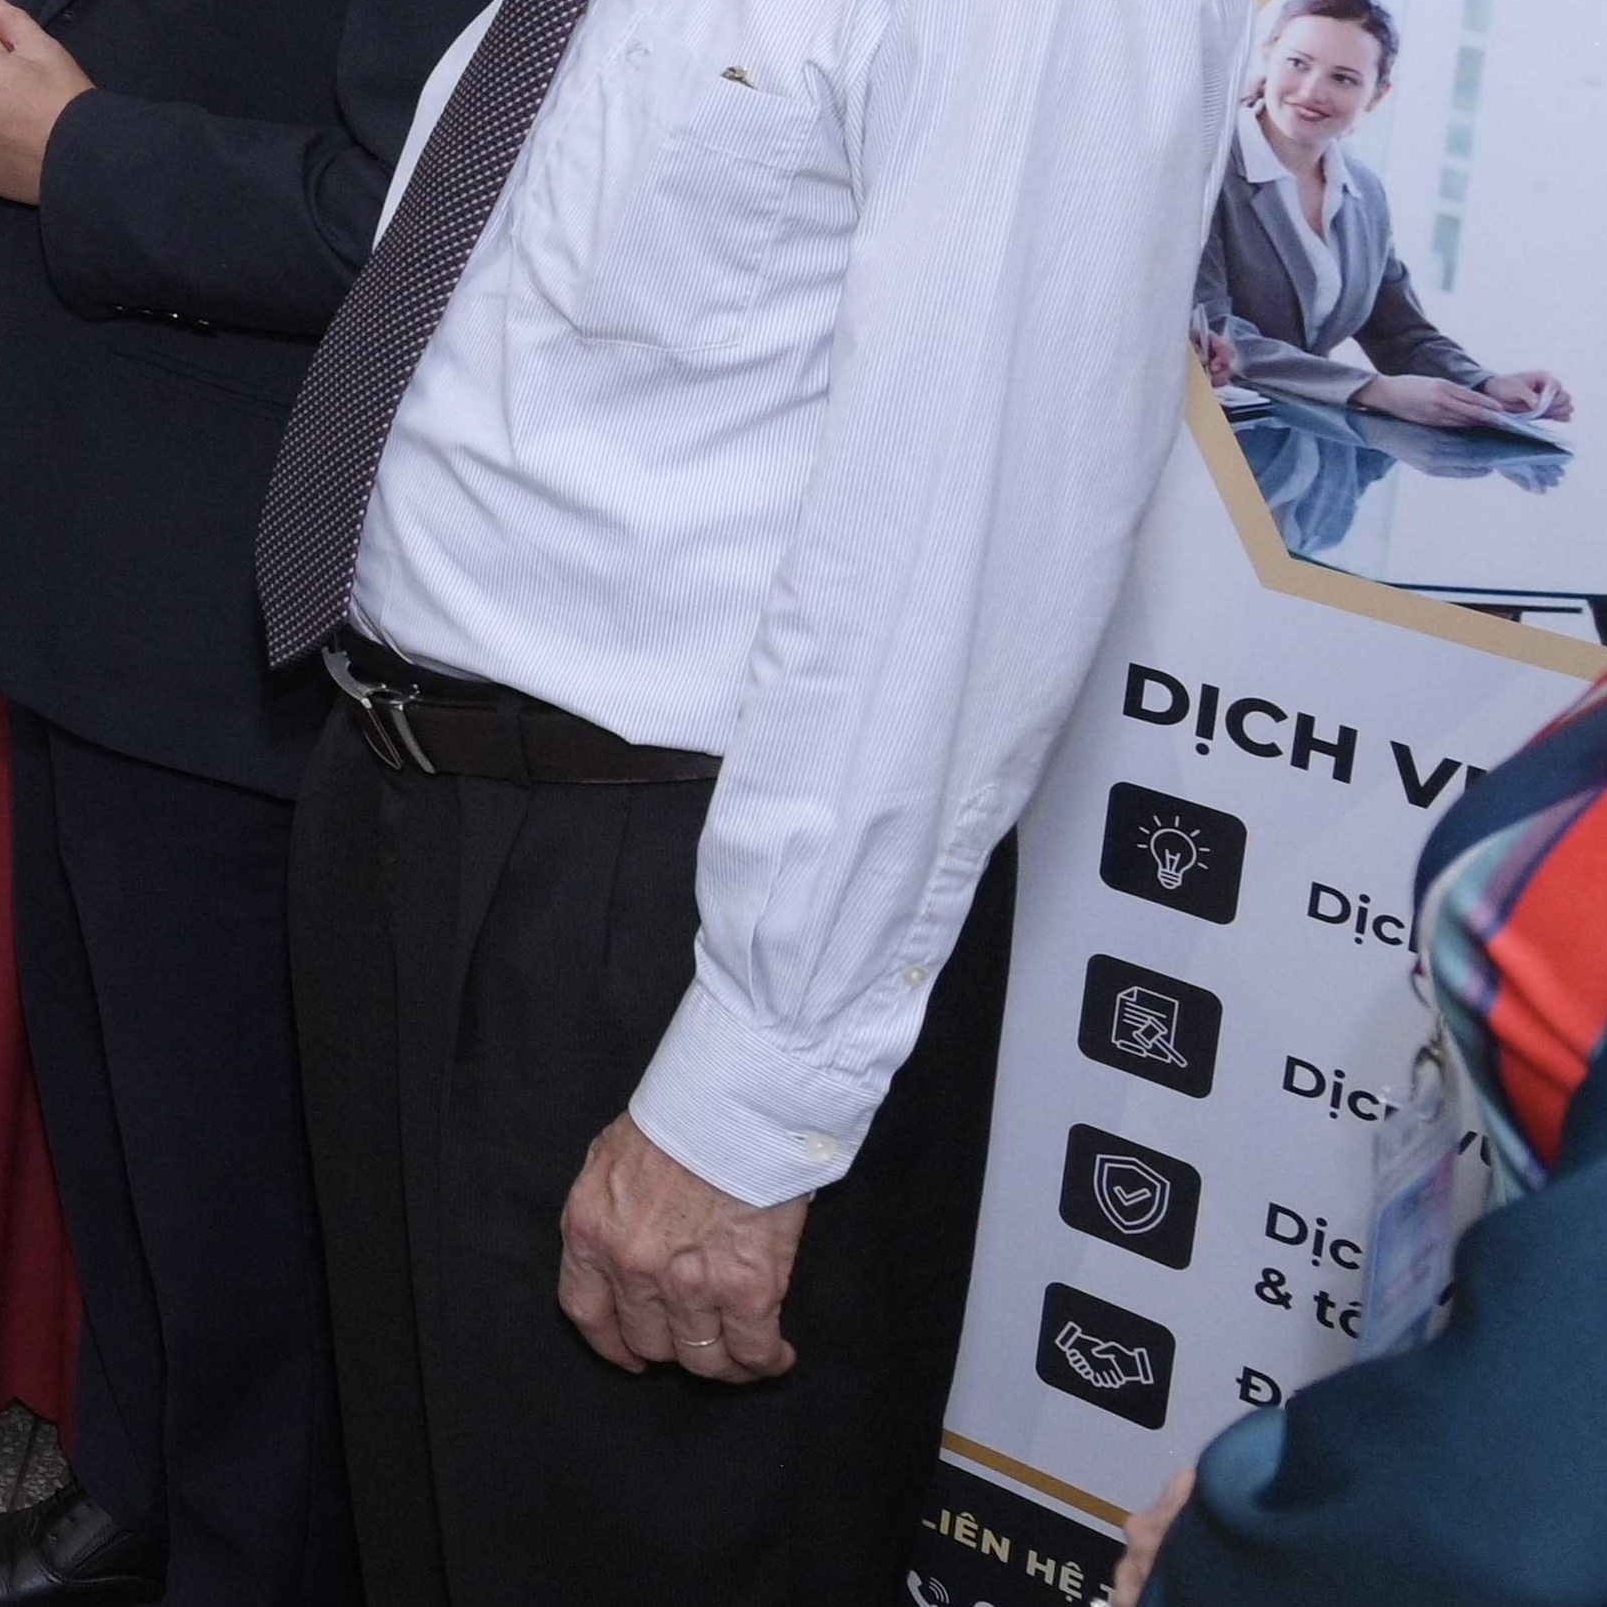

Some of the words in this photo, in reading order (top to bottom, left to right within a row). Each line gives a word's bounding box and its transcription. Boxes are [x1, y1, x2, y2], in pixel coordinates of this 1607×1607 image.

[1123, 662, 1358, 785] DỊCH
[1307, 881, 1419, 955] Dịc
[1265, 1201, 1363, 1271] Dịc
[1254, 1266, 1292, 1311] &
[1026, 1550, 1085, 1603] HỆ
